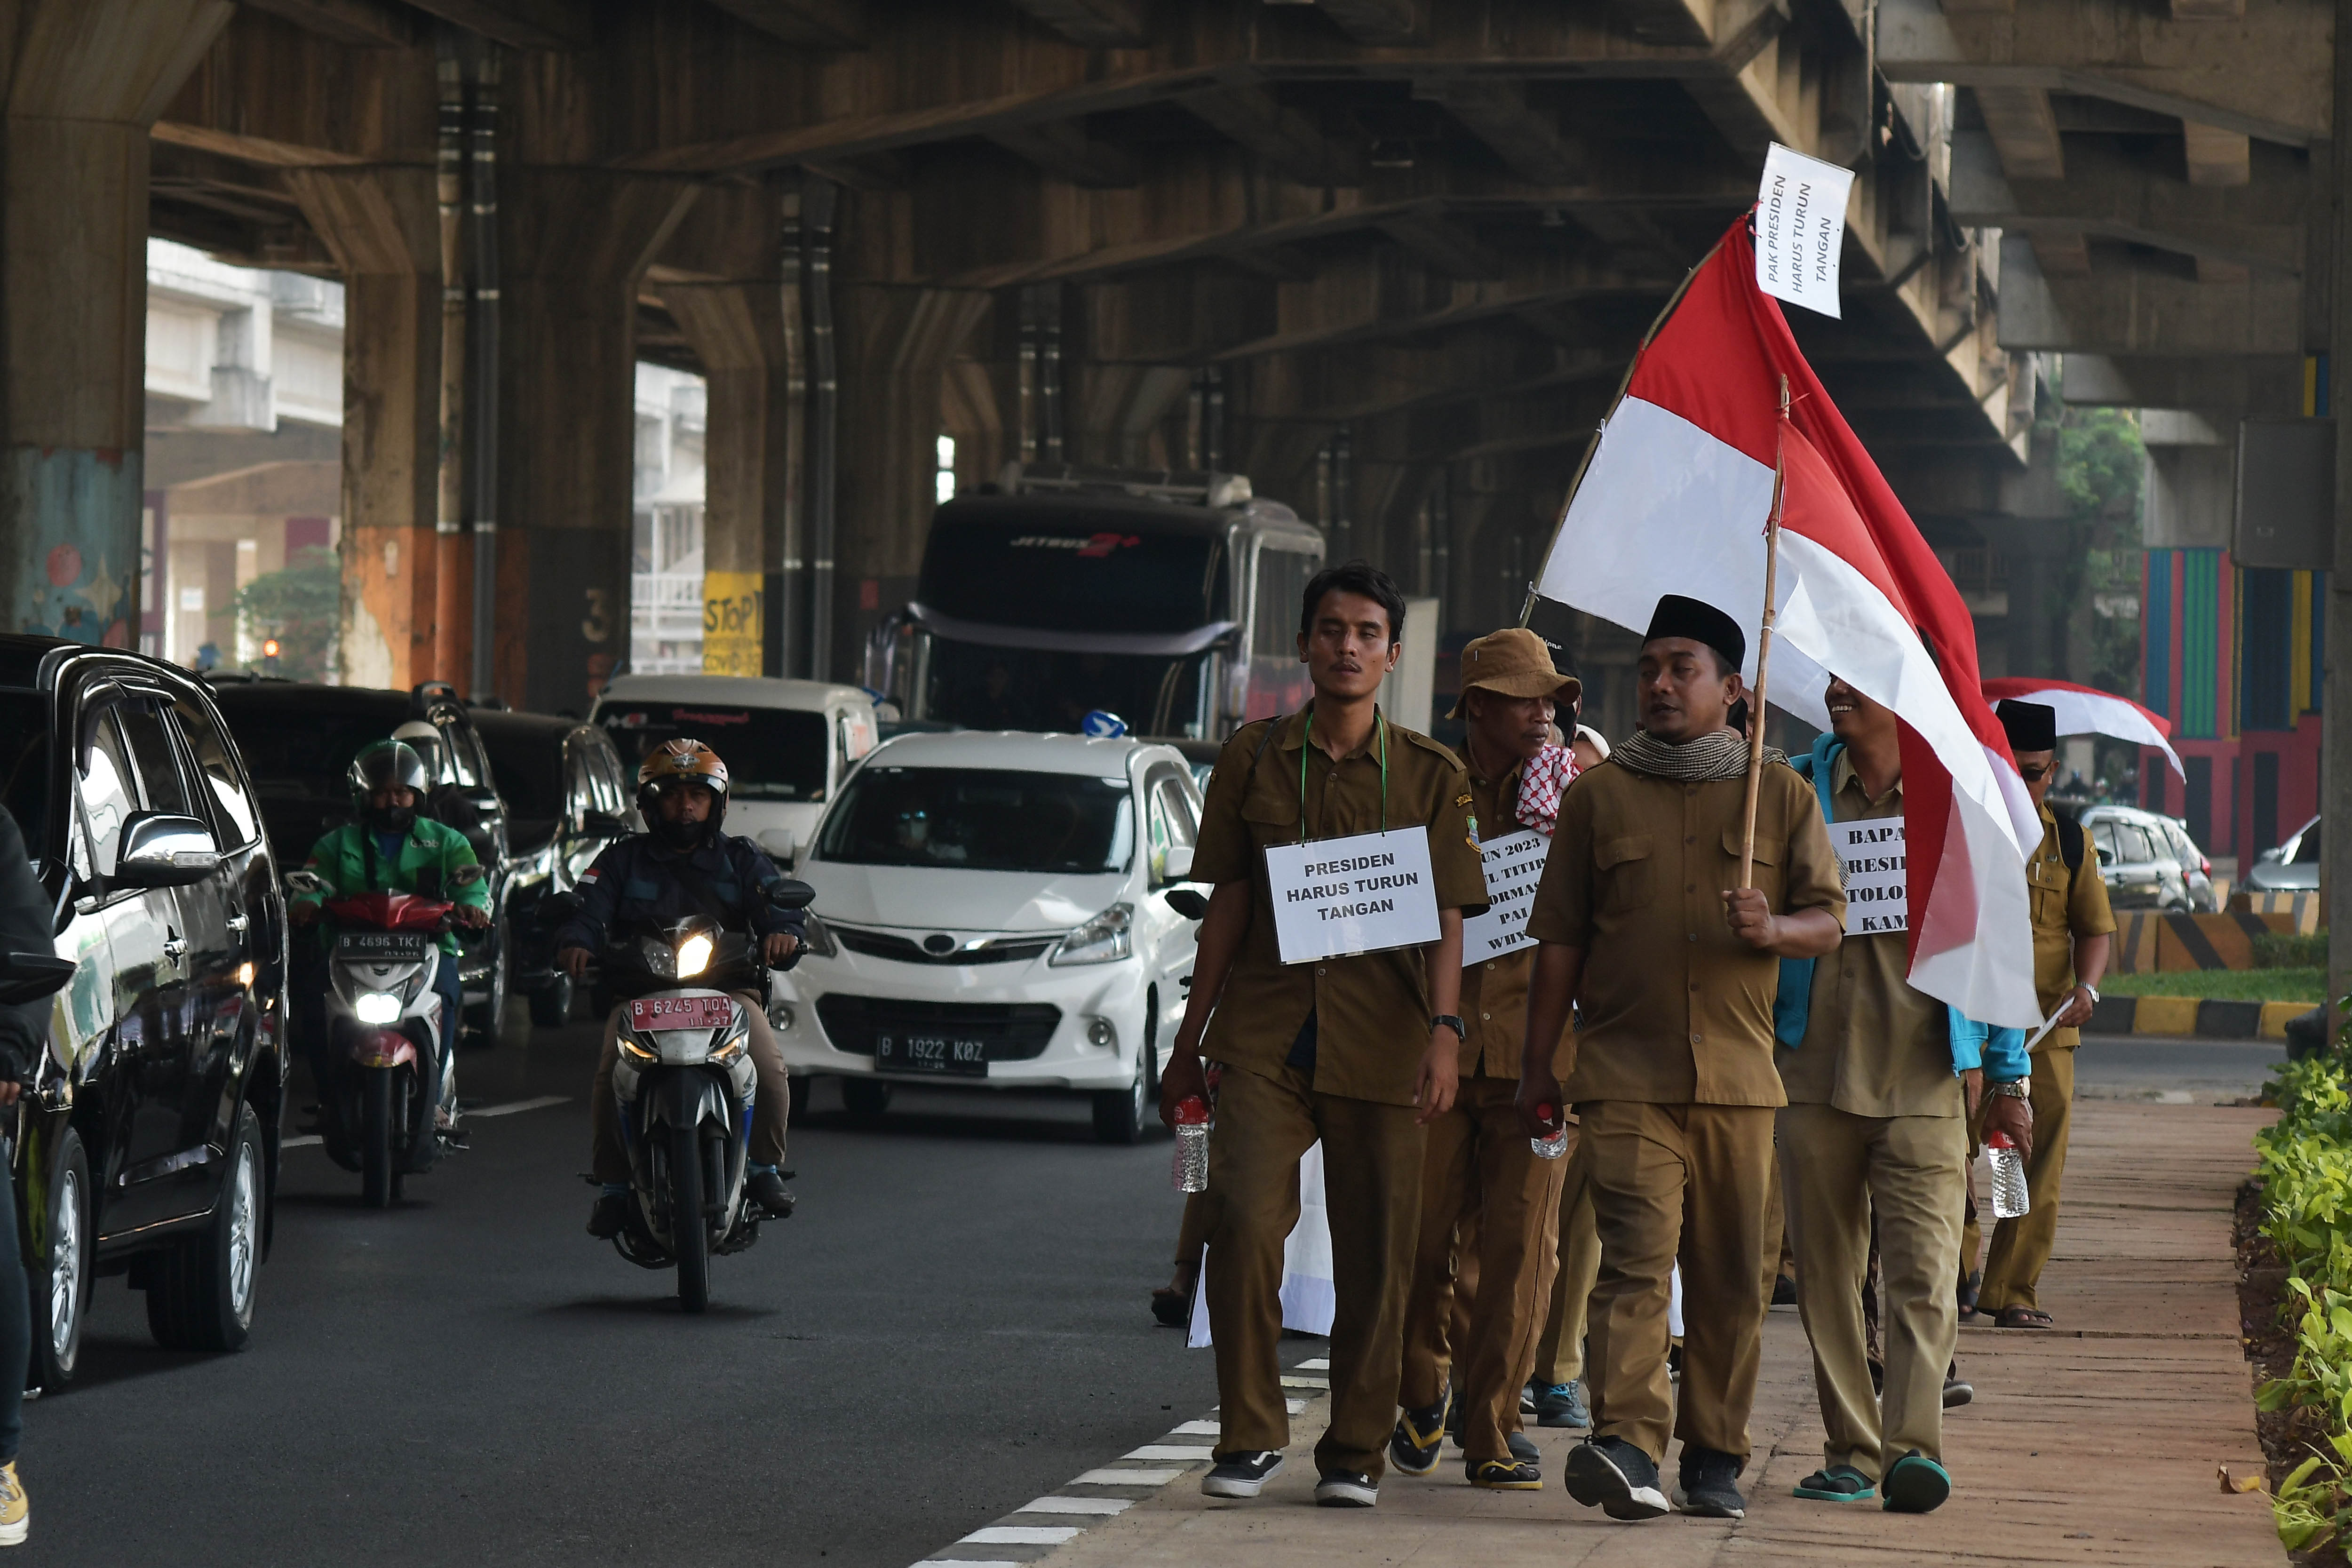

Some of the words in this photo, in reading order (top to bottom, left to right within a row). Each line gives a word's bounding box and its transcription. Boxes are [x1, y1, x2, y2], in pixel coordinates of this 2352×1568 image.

[1768, 175, 1787, 250] PRESIDEN
[1793, 183, 1811, 238] TURUN
[1816, 217, 1831, 282] TANGAN
[1768, 252, 1779, 283] PAK
[1792, 242, 1803, 294] HARUS
[1848, 827, 1905, 845] BAPA
[1481, 848, 1501, 863] UN
[1505, 837, 1541, 856] 2023
[1304, 852, 1395, 877] PRESIDEN
[1501, 858, 1546, 879] TITIP
[1845, 856, 1906, 874] RESI
[1287, 882, 1350, 902] HARUS
[1354, 872, 1419, 892] TURUN
[1846, 885, 1907, 903] TOLO
[1317, 899, 1394, 921] TANGAN
[1499, 907, 1528, 925] PAI
[1862, 914, 1908, 931] KAM
[343, 937, 350, 947] B
[635, 1002, 644, 1015] B
[653, 998, 693, 1013] 6245
[882, 1037, 892, 1056] B
[907, 1038, 945, 1059] 1922
